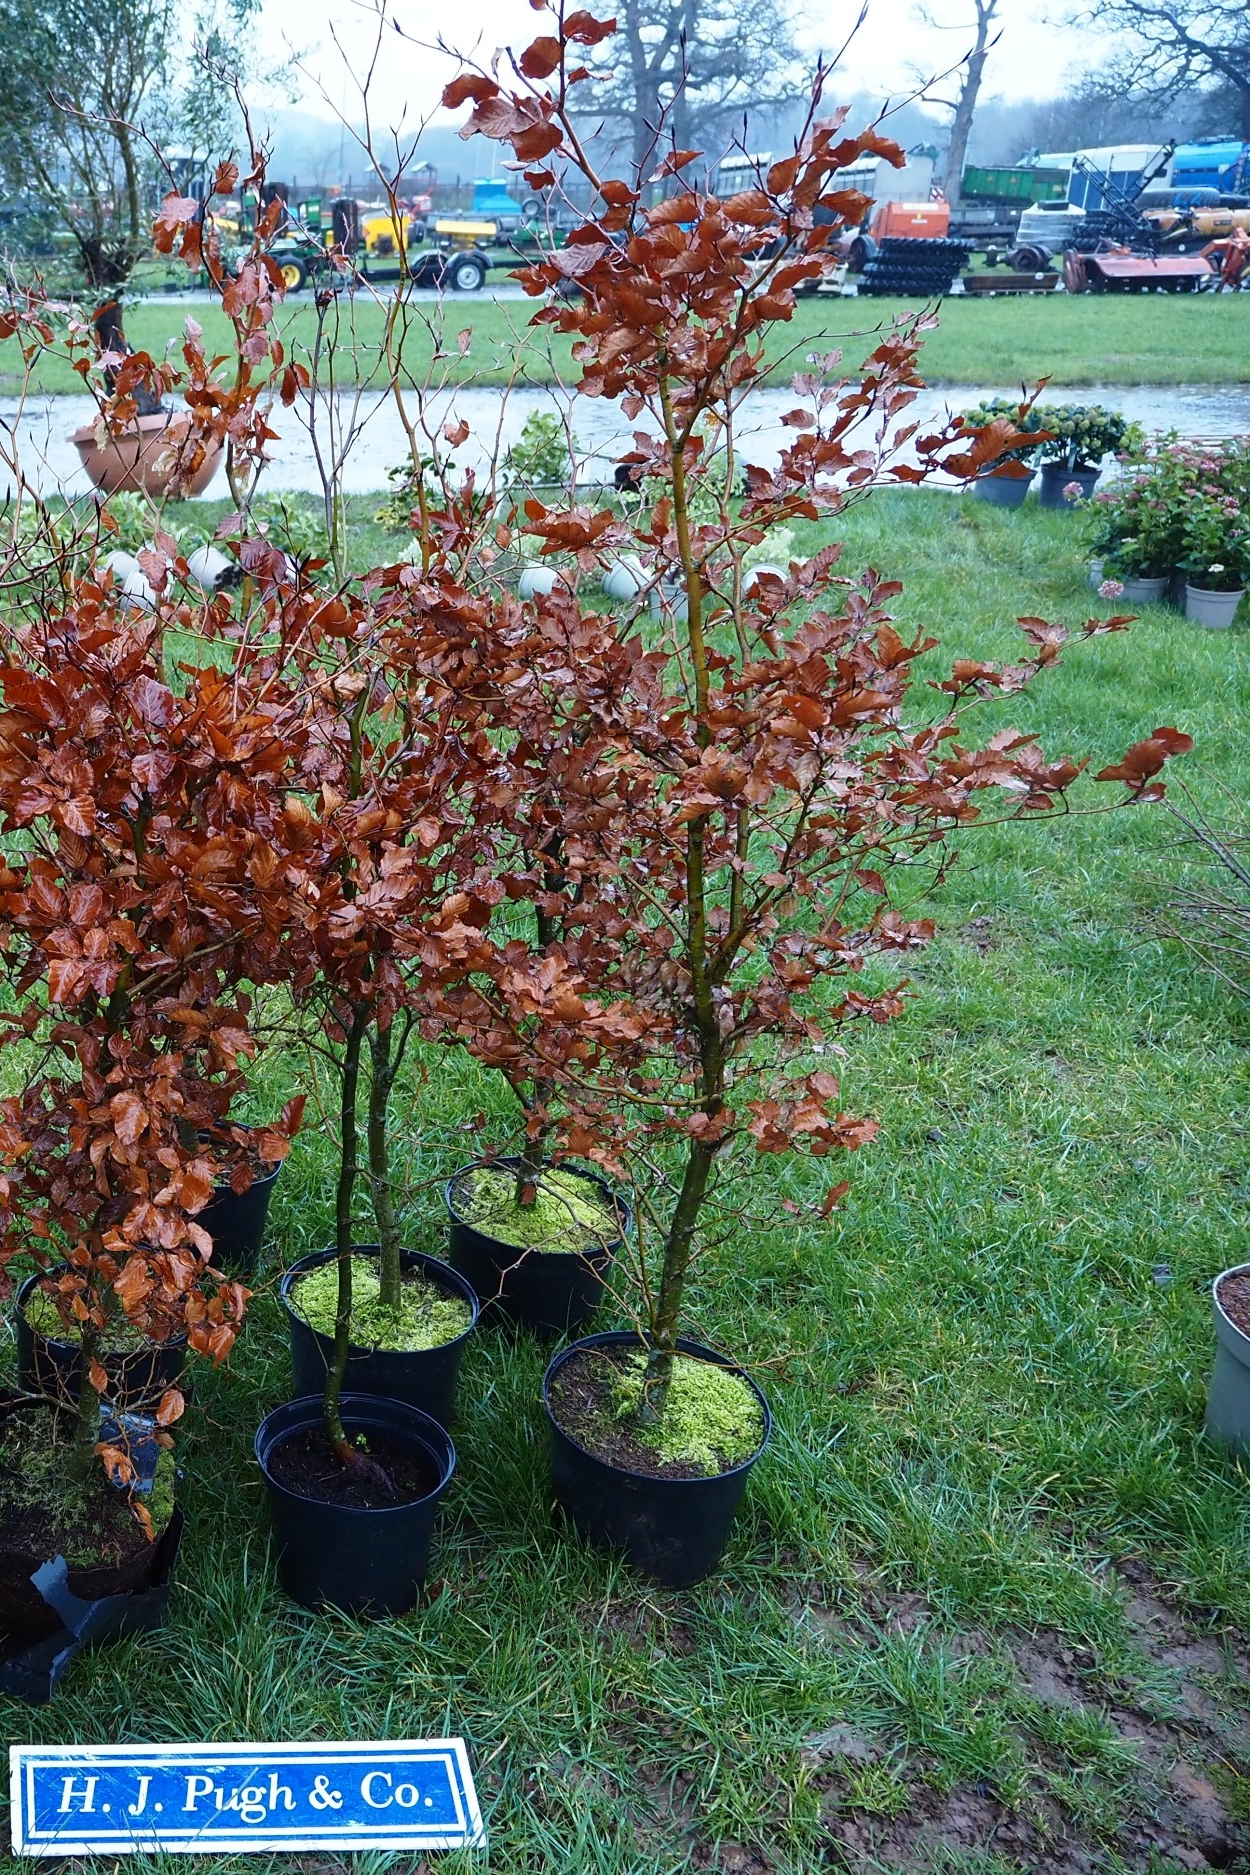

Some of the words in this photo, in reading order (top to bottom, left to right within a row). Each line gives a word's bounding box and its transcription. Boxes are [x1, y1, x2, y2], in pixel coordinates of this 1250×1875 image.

[57, 1775, 111, 1813] H.
[128, 1775, 163, 1816] J.
[181, 1773, 297, 1824] Pugh
[308, 1775, 344, 1810] &
[360, 1771, 434, 1809] Co.
